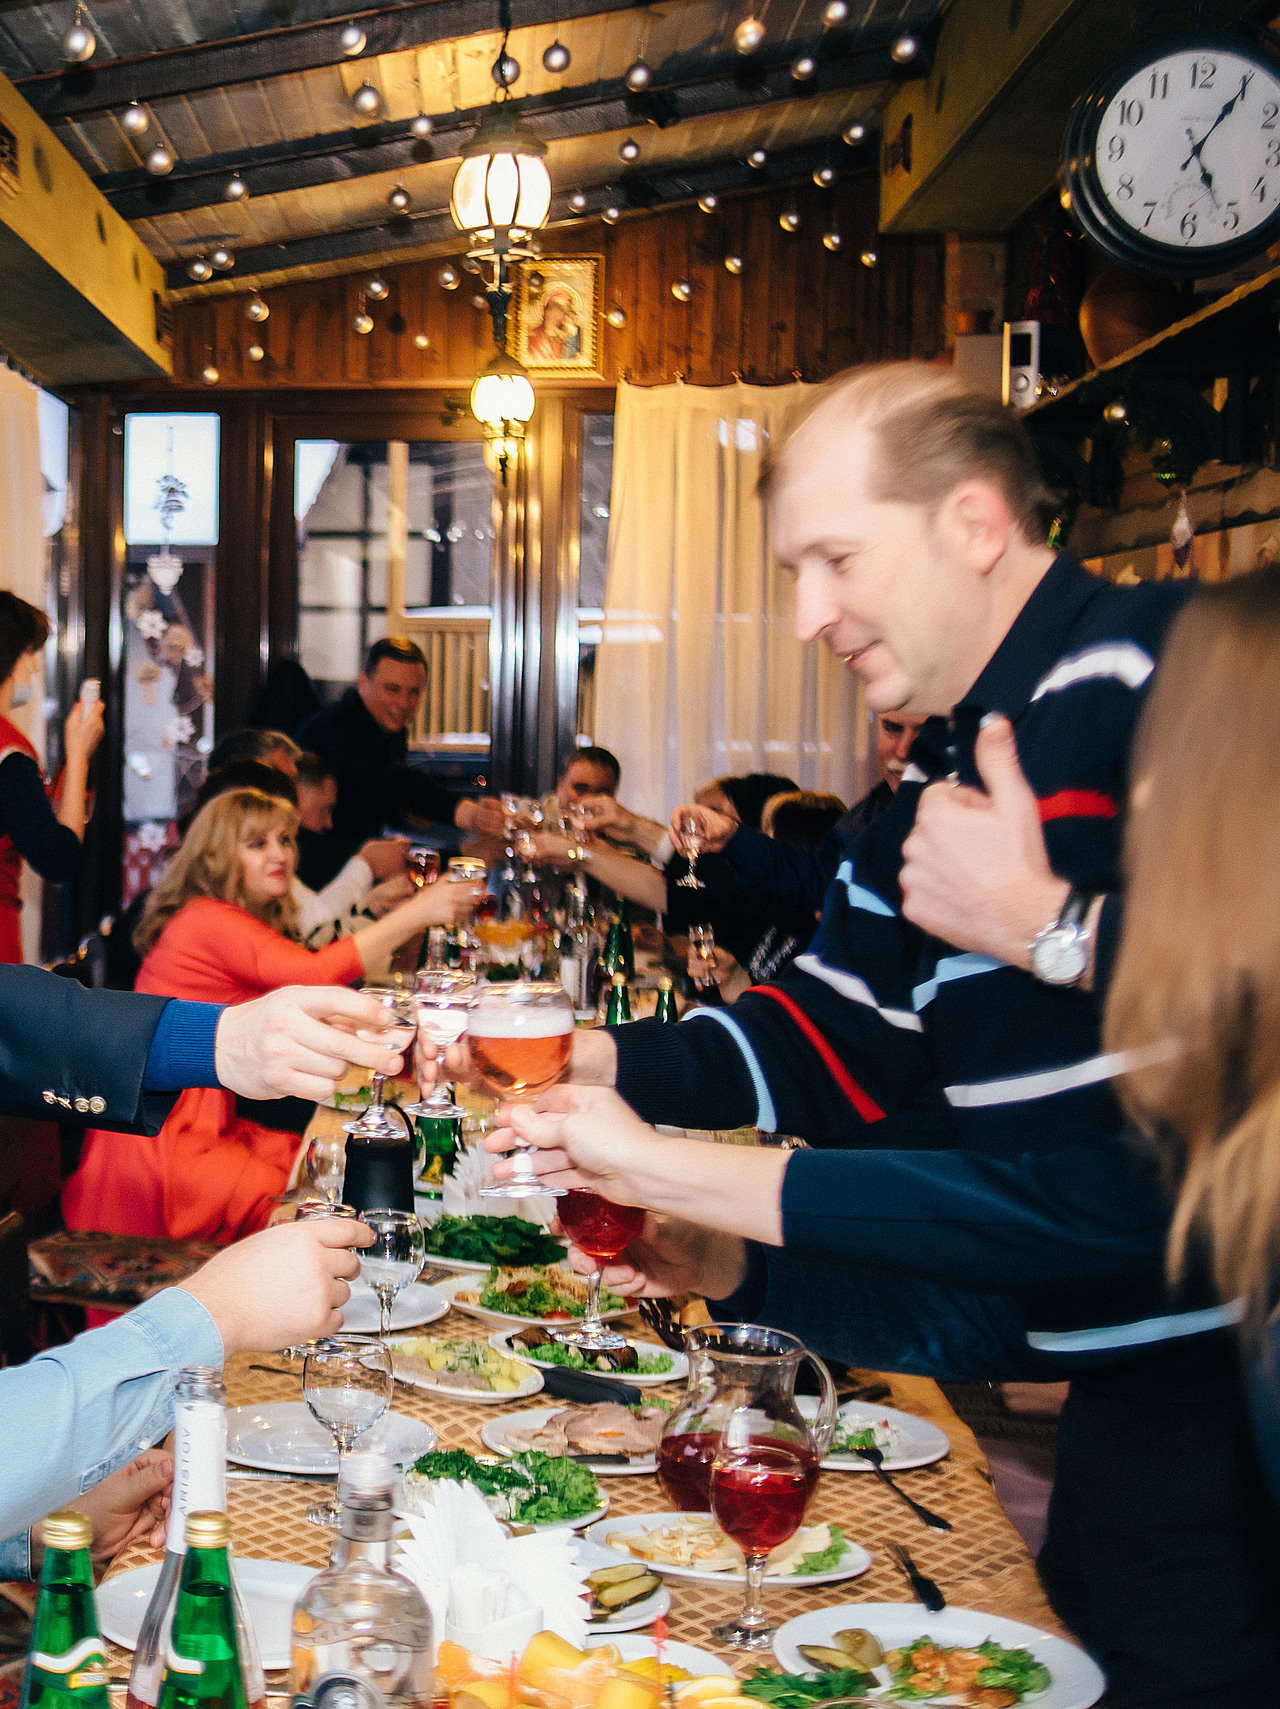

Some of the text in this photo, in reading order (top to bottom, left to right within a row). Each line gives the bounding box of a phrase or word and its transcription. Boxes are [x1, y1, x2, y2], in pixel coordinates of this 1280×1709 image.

[1148, 73, 1169, 99] 11
[1190, 61, 1217, 89] 12
[1238, 75, 1248, 101] 1
[1118, 99, 1144, 127] 10
[1261, 102, 1279, 130] 2
[1108, 135, 1125, 163] 9
[1265, 140, 1280, 168] 3
[1116, 173, 1134, 201] 8
[1250, 176, 1267, 203] 4
[1143, 201, 1159, 228] 7
[1180, 211, 1198, 240] 6
[1223, 201, 1240, 231] 5
